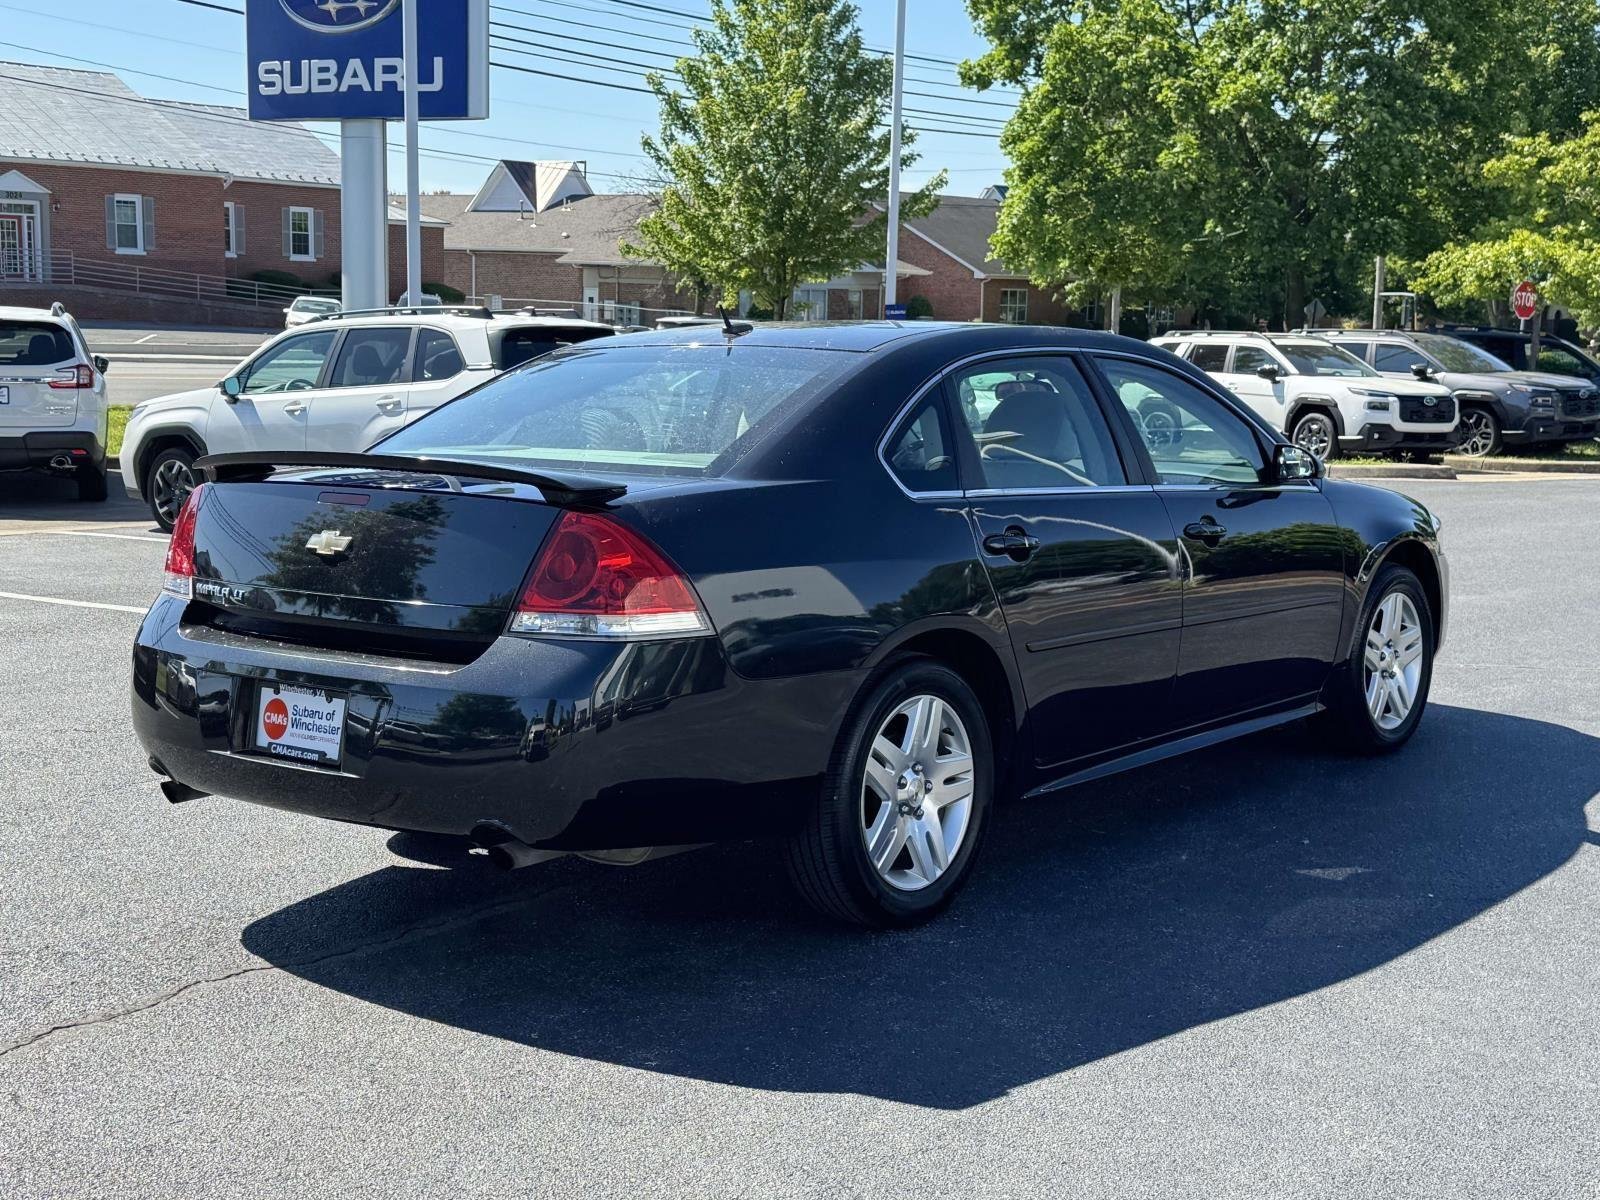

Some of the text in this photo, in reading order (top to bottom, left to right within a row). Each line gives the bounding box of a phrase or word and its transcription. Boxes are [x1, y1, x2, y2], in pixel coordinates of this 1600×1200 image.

[258, 57, 443, 96] SUBARU
[1515, 292, 1536, 307] STOP
[196, 582, 245, 600] IMPALA LT
[316, 689, 325, 697] VA
[264, 712, 288, 726] CMA's
[292, 704, 336, 722] Subaru of
[291, 717, 340, 735] Winchester
[271, 744, 319, 761] CMAcars.com
